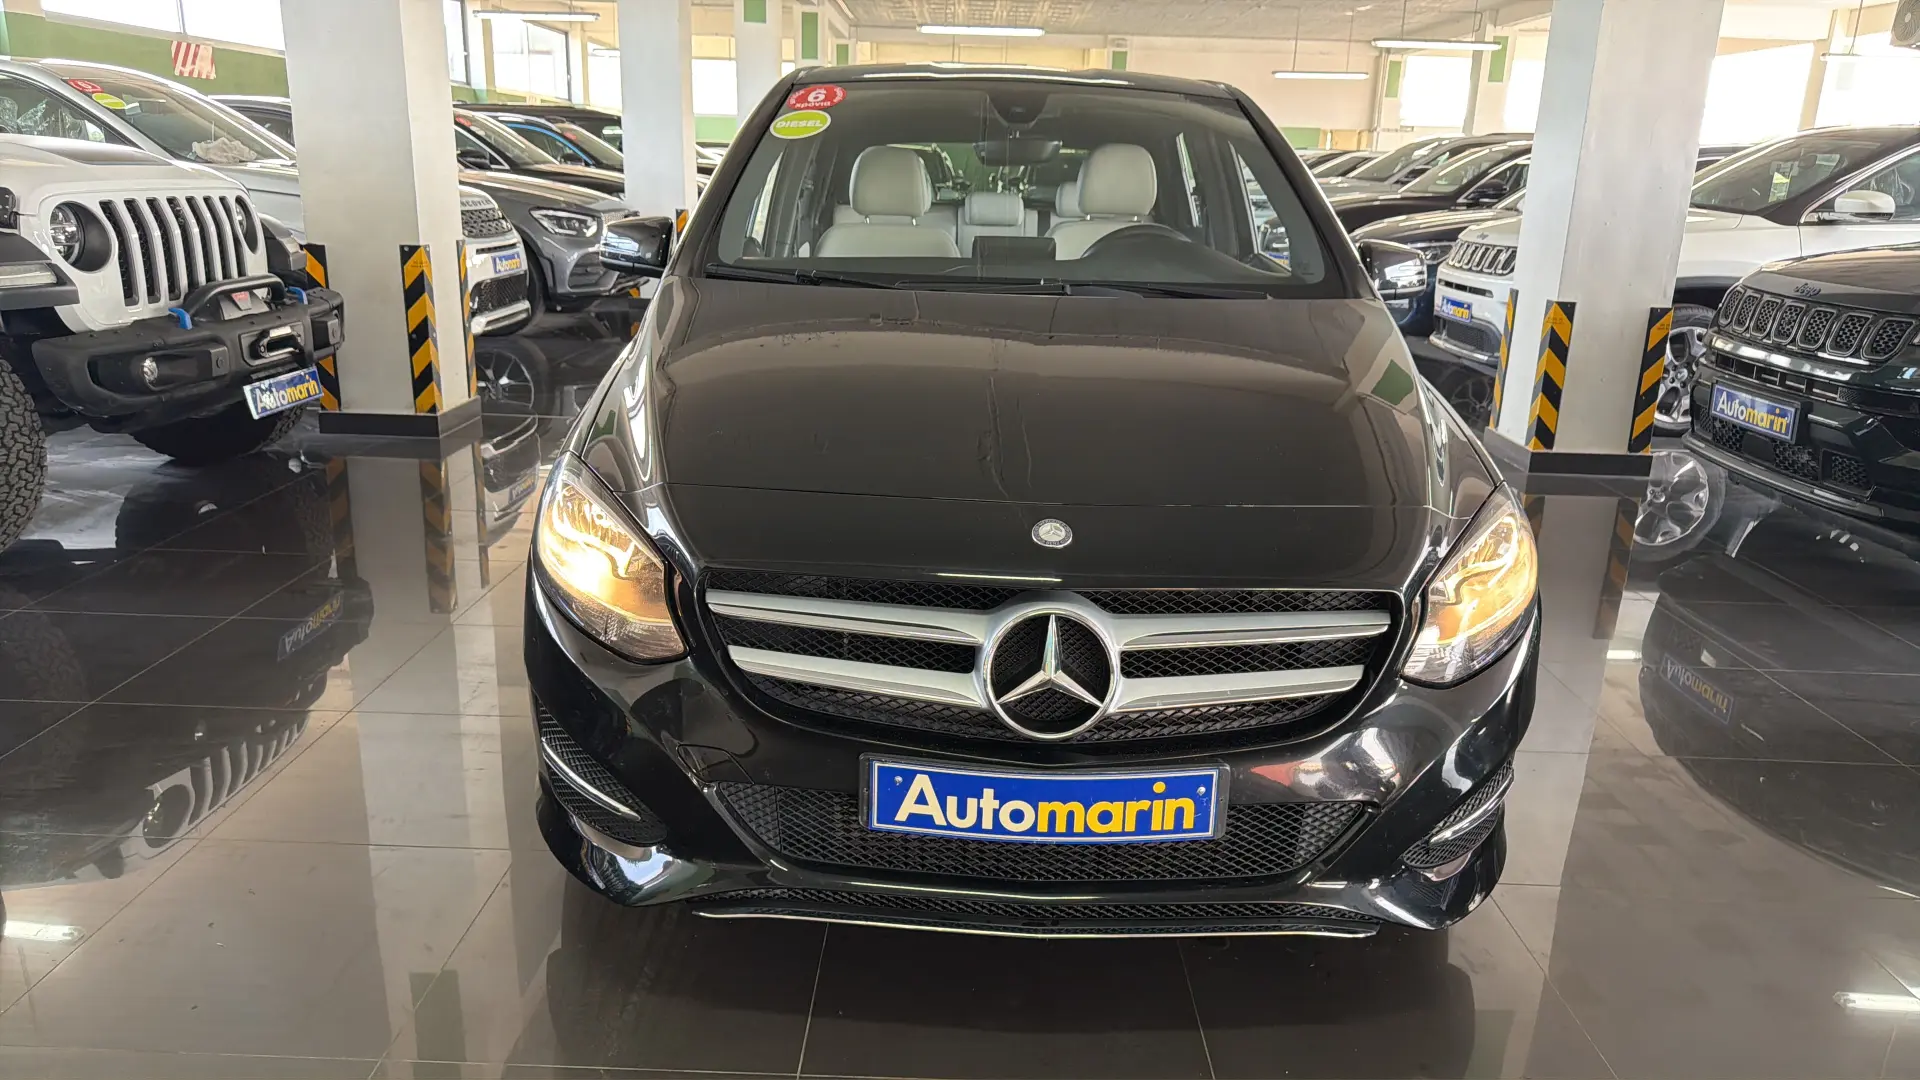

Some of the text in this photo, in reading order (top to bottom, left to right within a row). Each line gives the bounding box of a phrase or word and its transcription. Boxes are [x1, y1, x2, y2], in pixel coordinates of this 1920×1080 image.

[808, 89, 827, 102] 6
[776, 120, 823, 128] DIESEL
[255, 374, 319, 412] Automarin
[1716, 391, 1788, 433] Automarin
[894, 774, 1195, 833] Automarin
